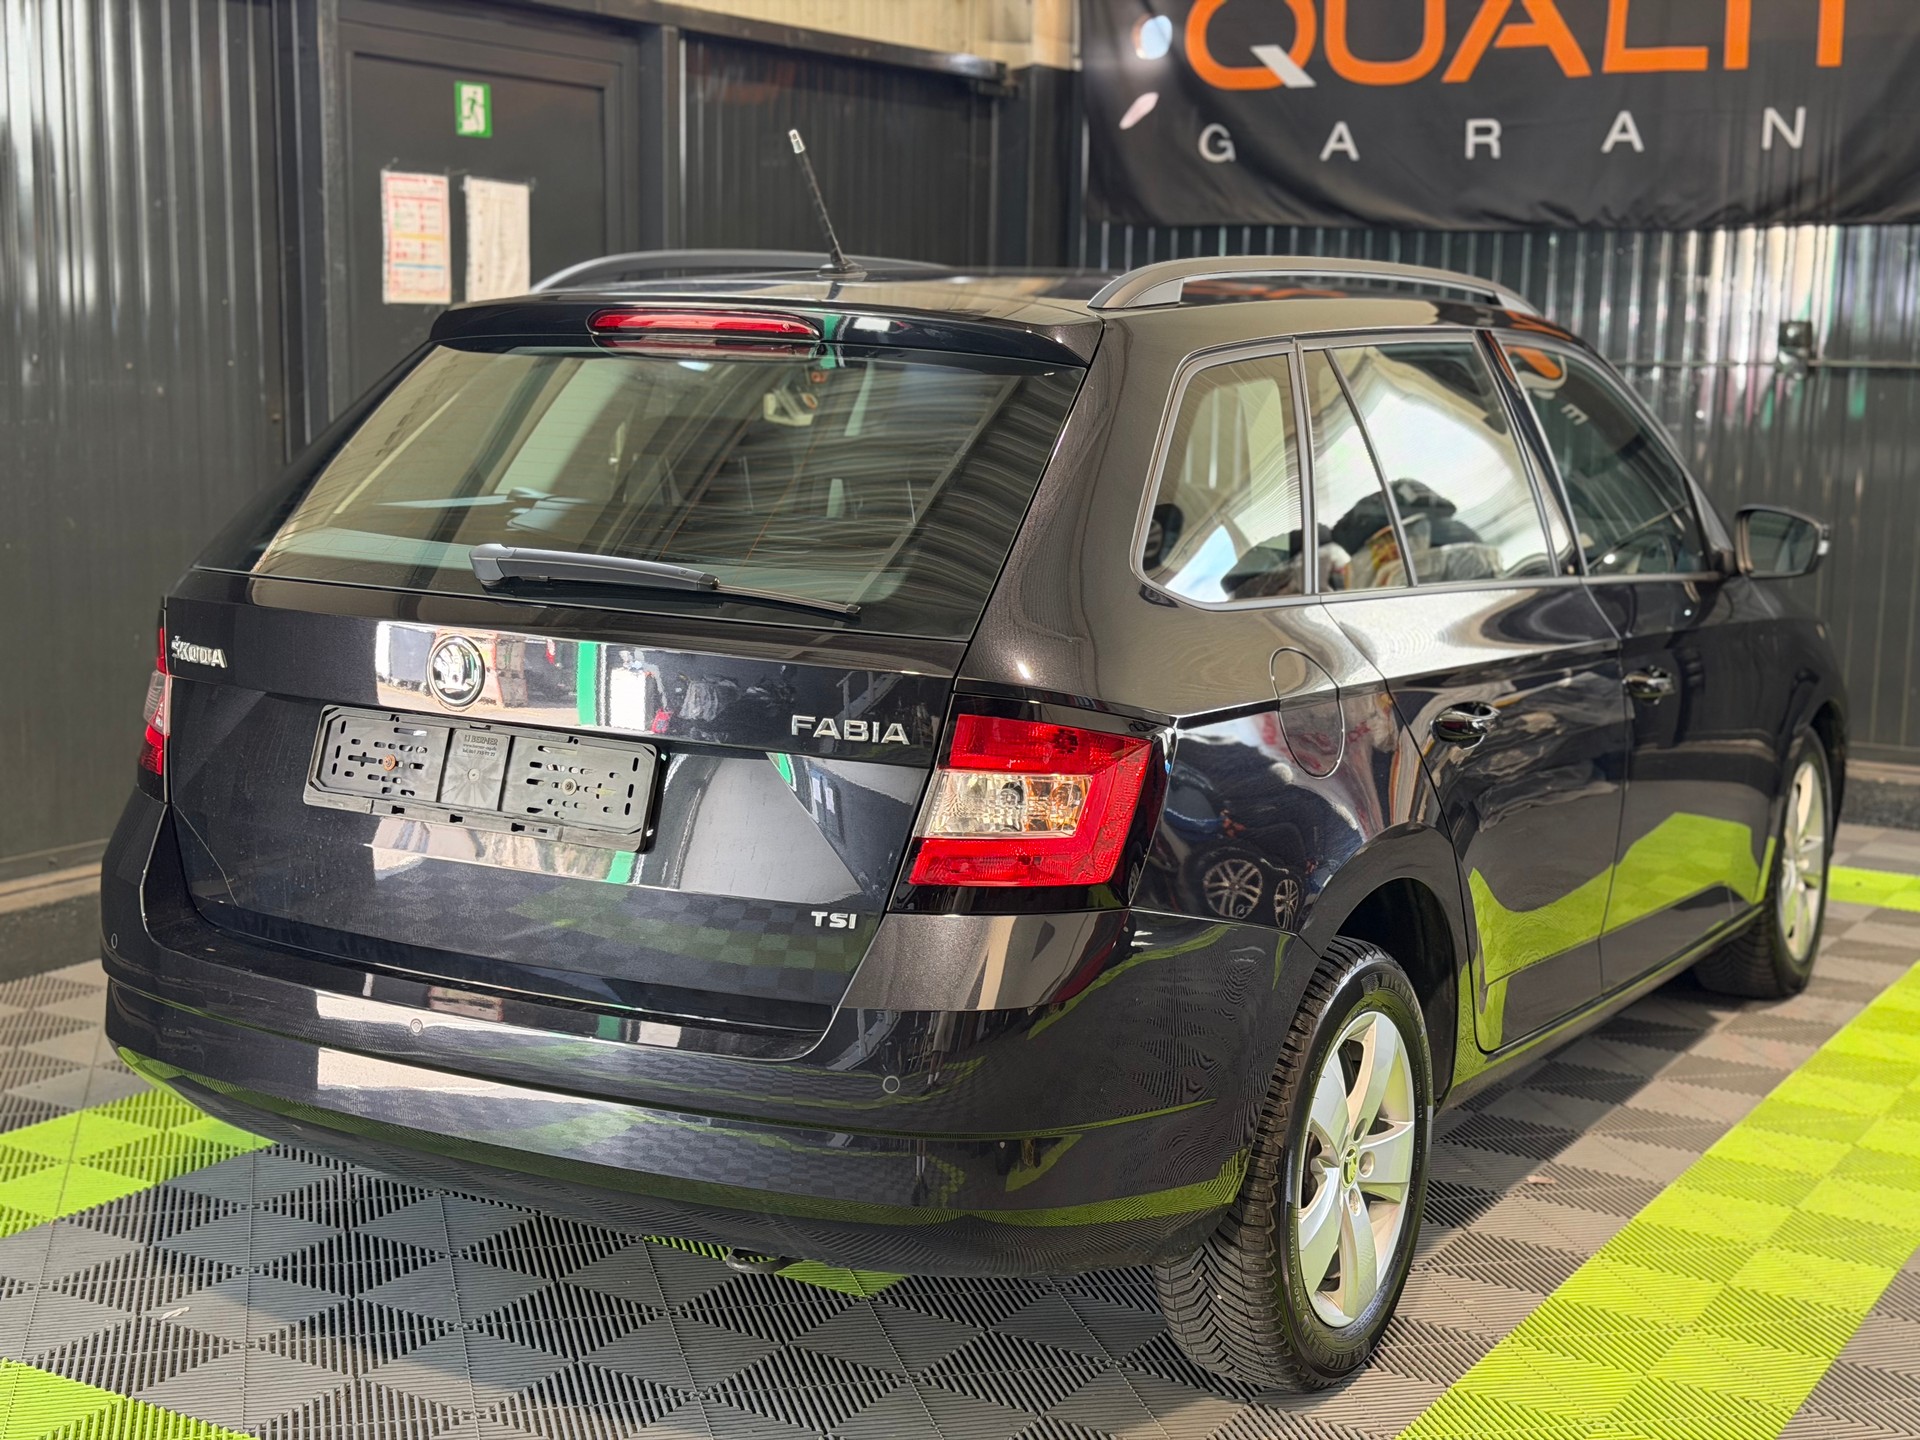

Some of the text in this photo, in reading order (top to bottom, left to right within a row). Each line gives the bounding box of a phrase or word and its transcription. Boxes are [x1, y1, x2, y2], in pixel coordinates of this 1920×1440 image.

[1198, 106, 1807, 163] GARAN
[171, 635, 228, 669] ŠKODA
[791, 714, 910, 745] FABIA
[811, 911, 857, 929] TSI
